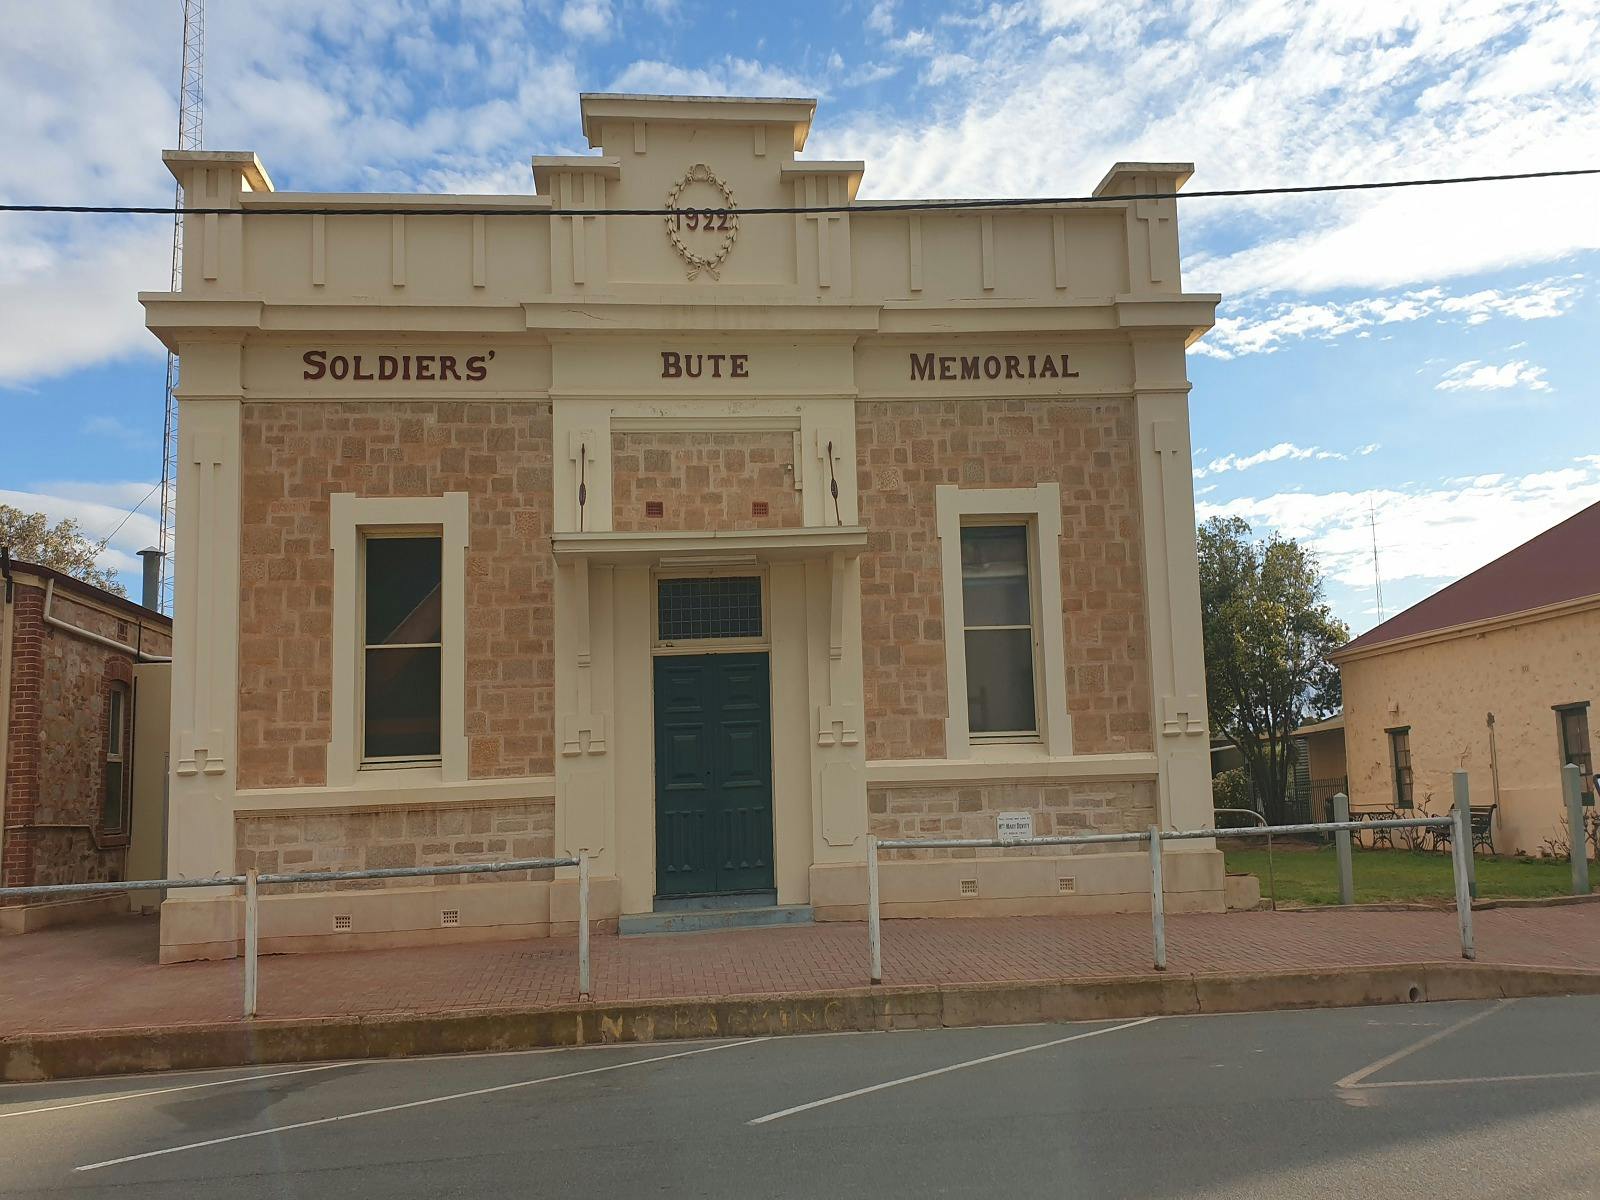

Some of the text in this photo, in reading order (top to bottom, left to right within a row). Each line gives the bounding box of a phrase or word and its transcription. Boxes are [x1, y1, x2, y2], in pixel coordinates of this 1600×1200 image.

[676, 207, 729, 231] 1922
[302, 350, 496, 381] SOLDIERS'
[660, 351, 749, 378] BUTE
[909, 352, 1080, 381] MEMORIAL
